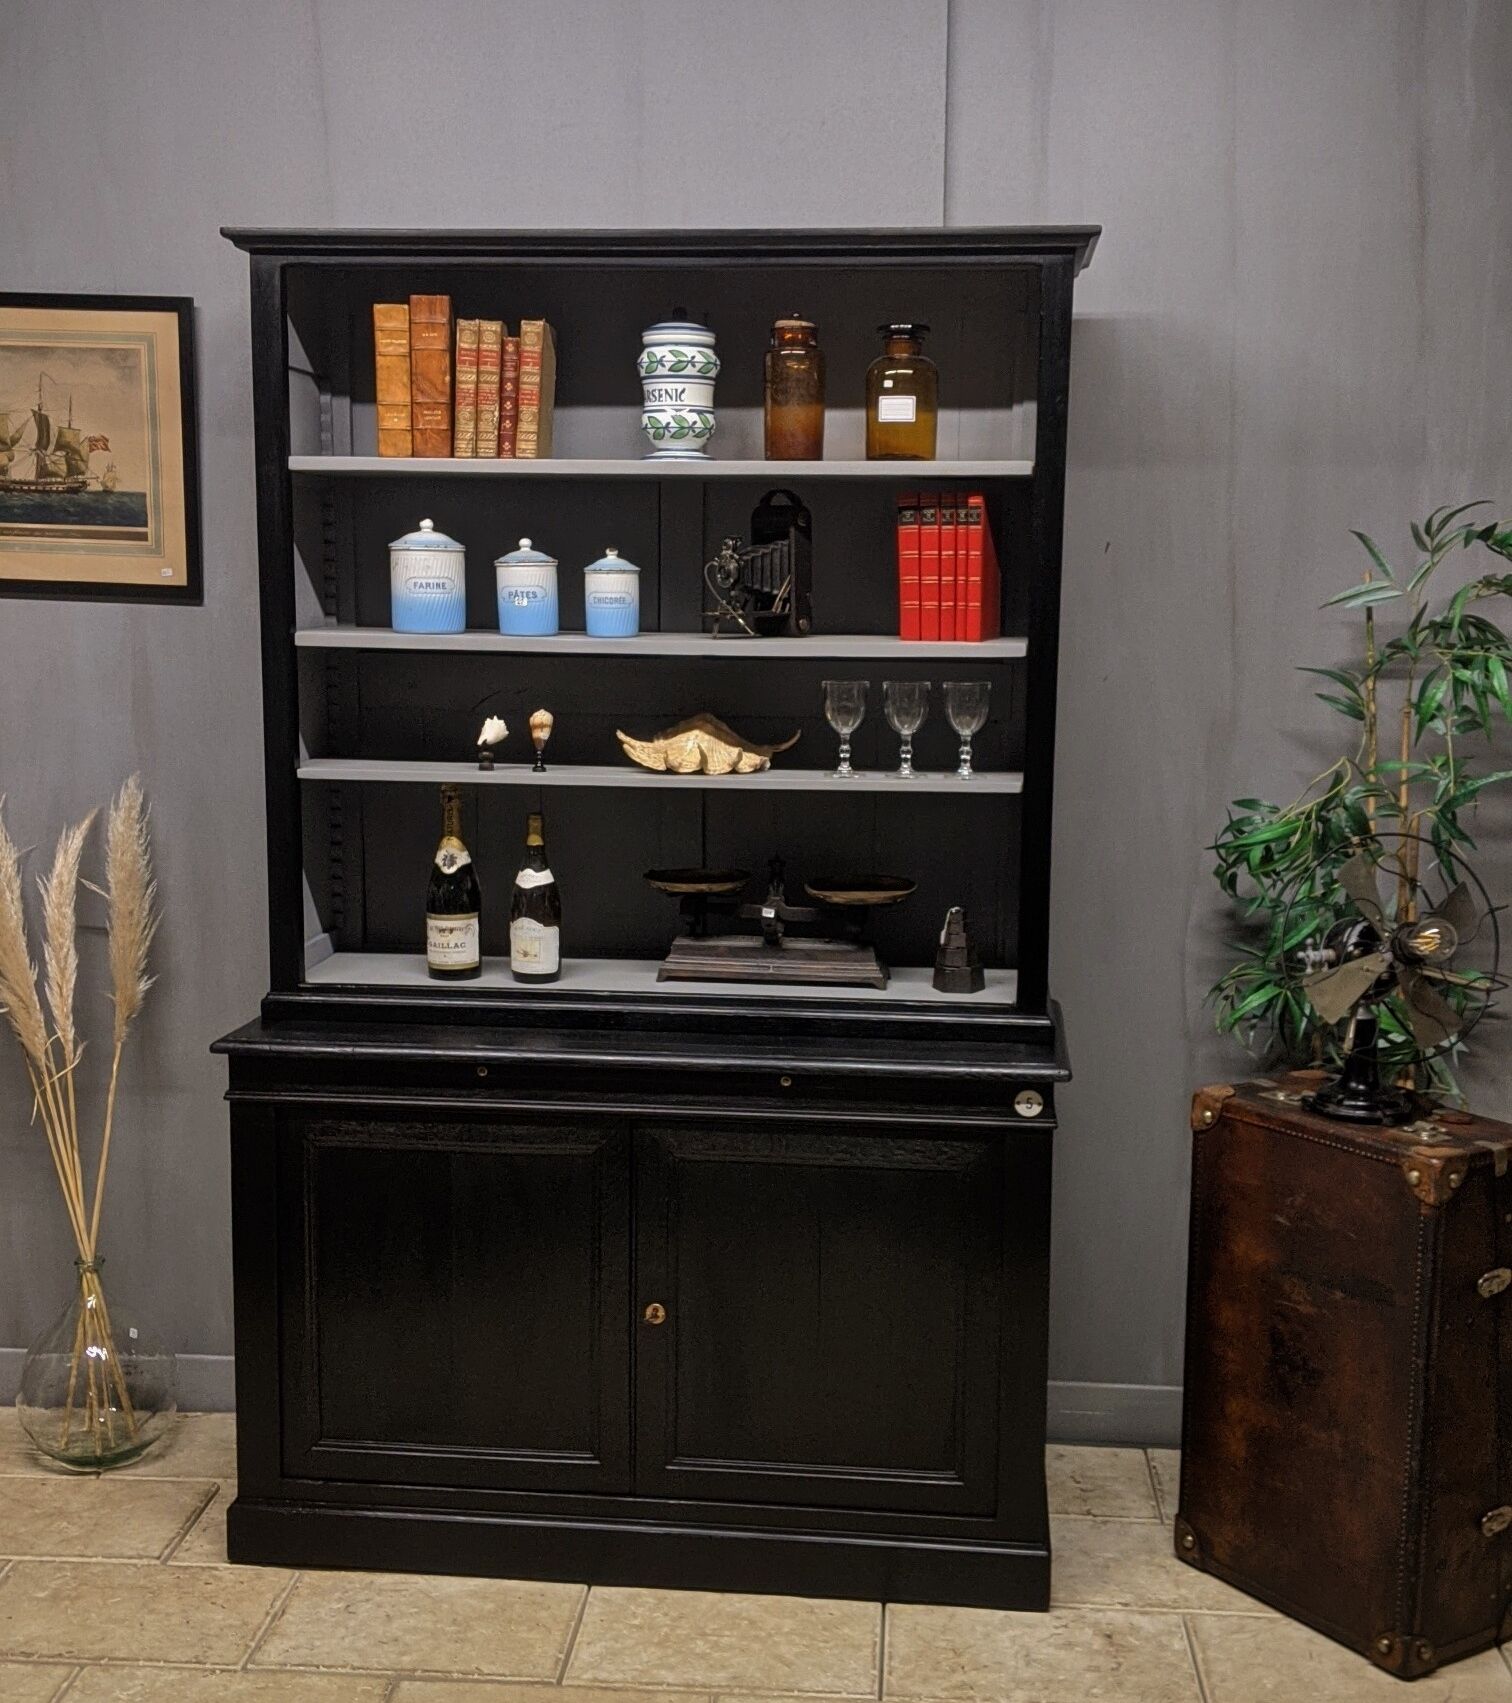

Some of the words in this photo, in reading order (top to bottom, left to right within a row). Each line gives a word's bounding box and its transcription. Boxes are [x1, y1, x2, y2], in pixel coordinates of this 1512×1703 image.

[644, 386, 687, 403] RSENIC
[413, 581, 447, 590] FARINE
[428, 941, 466, 949] GAILLAC
[1025, 1097, 1033, 1109] 5
